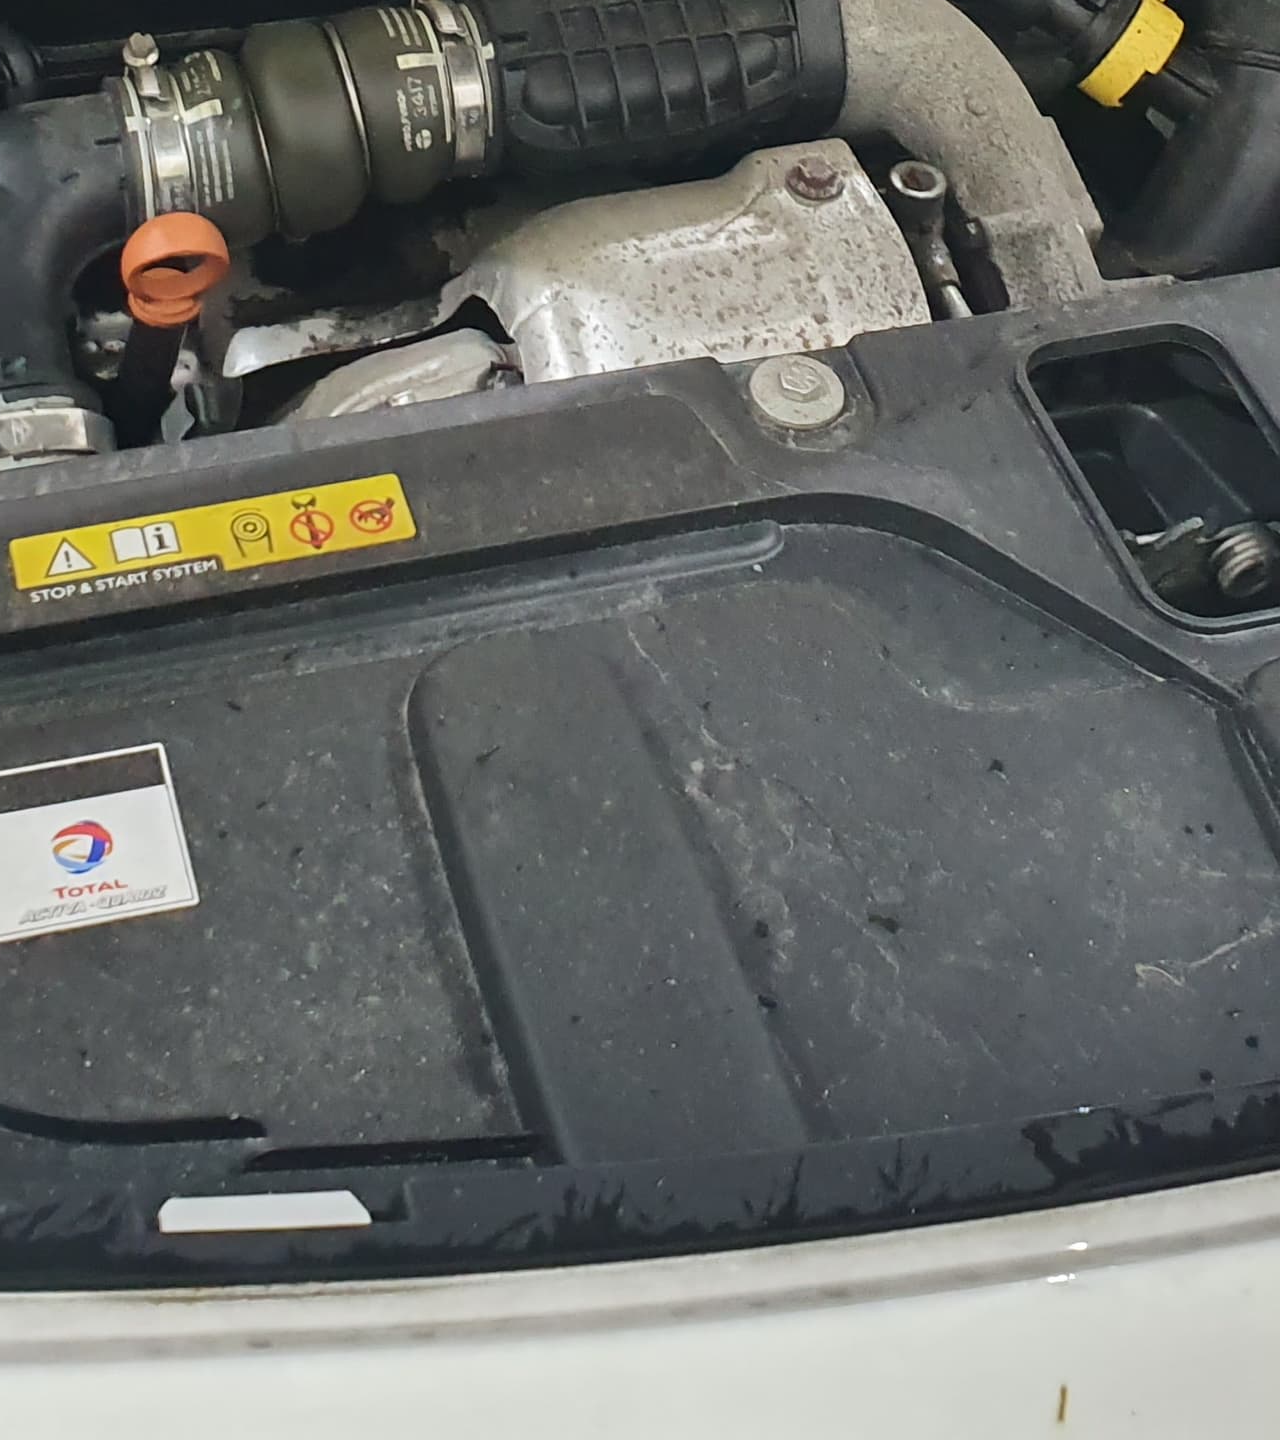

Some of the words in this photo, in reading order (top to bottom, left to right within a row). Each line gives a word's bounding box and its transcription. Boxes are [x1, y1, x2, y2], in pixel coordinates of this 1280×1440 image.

[29, 583, 77, 603] STOP
[80, 581, 93, 594] &
[95, 569, 150, 592] START
[152, 558, 218, 582] SYSTEM
[53, 879, 129, 899] TOTAL
